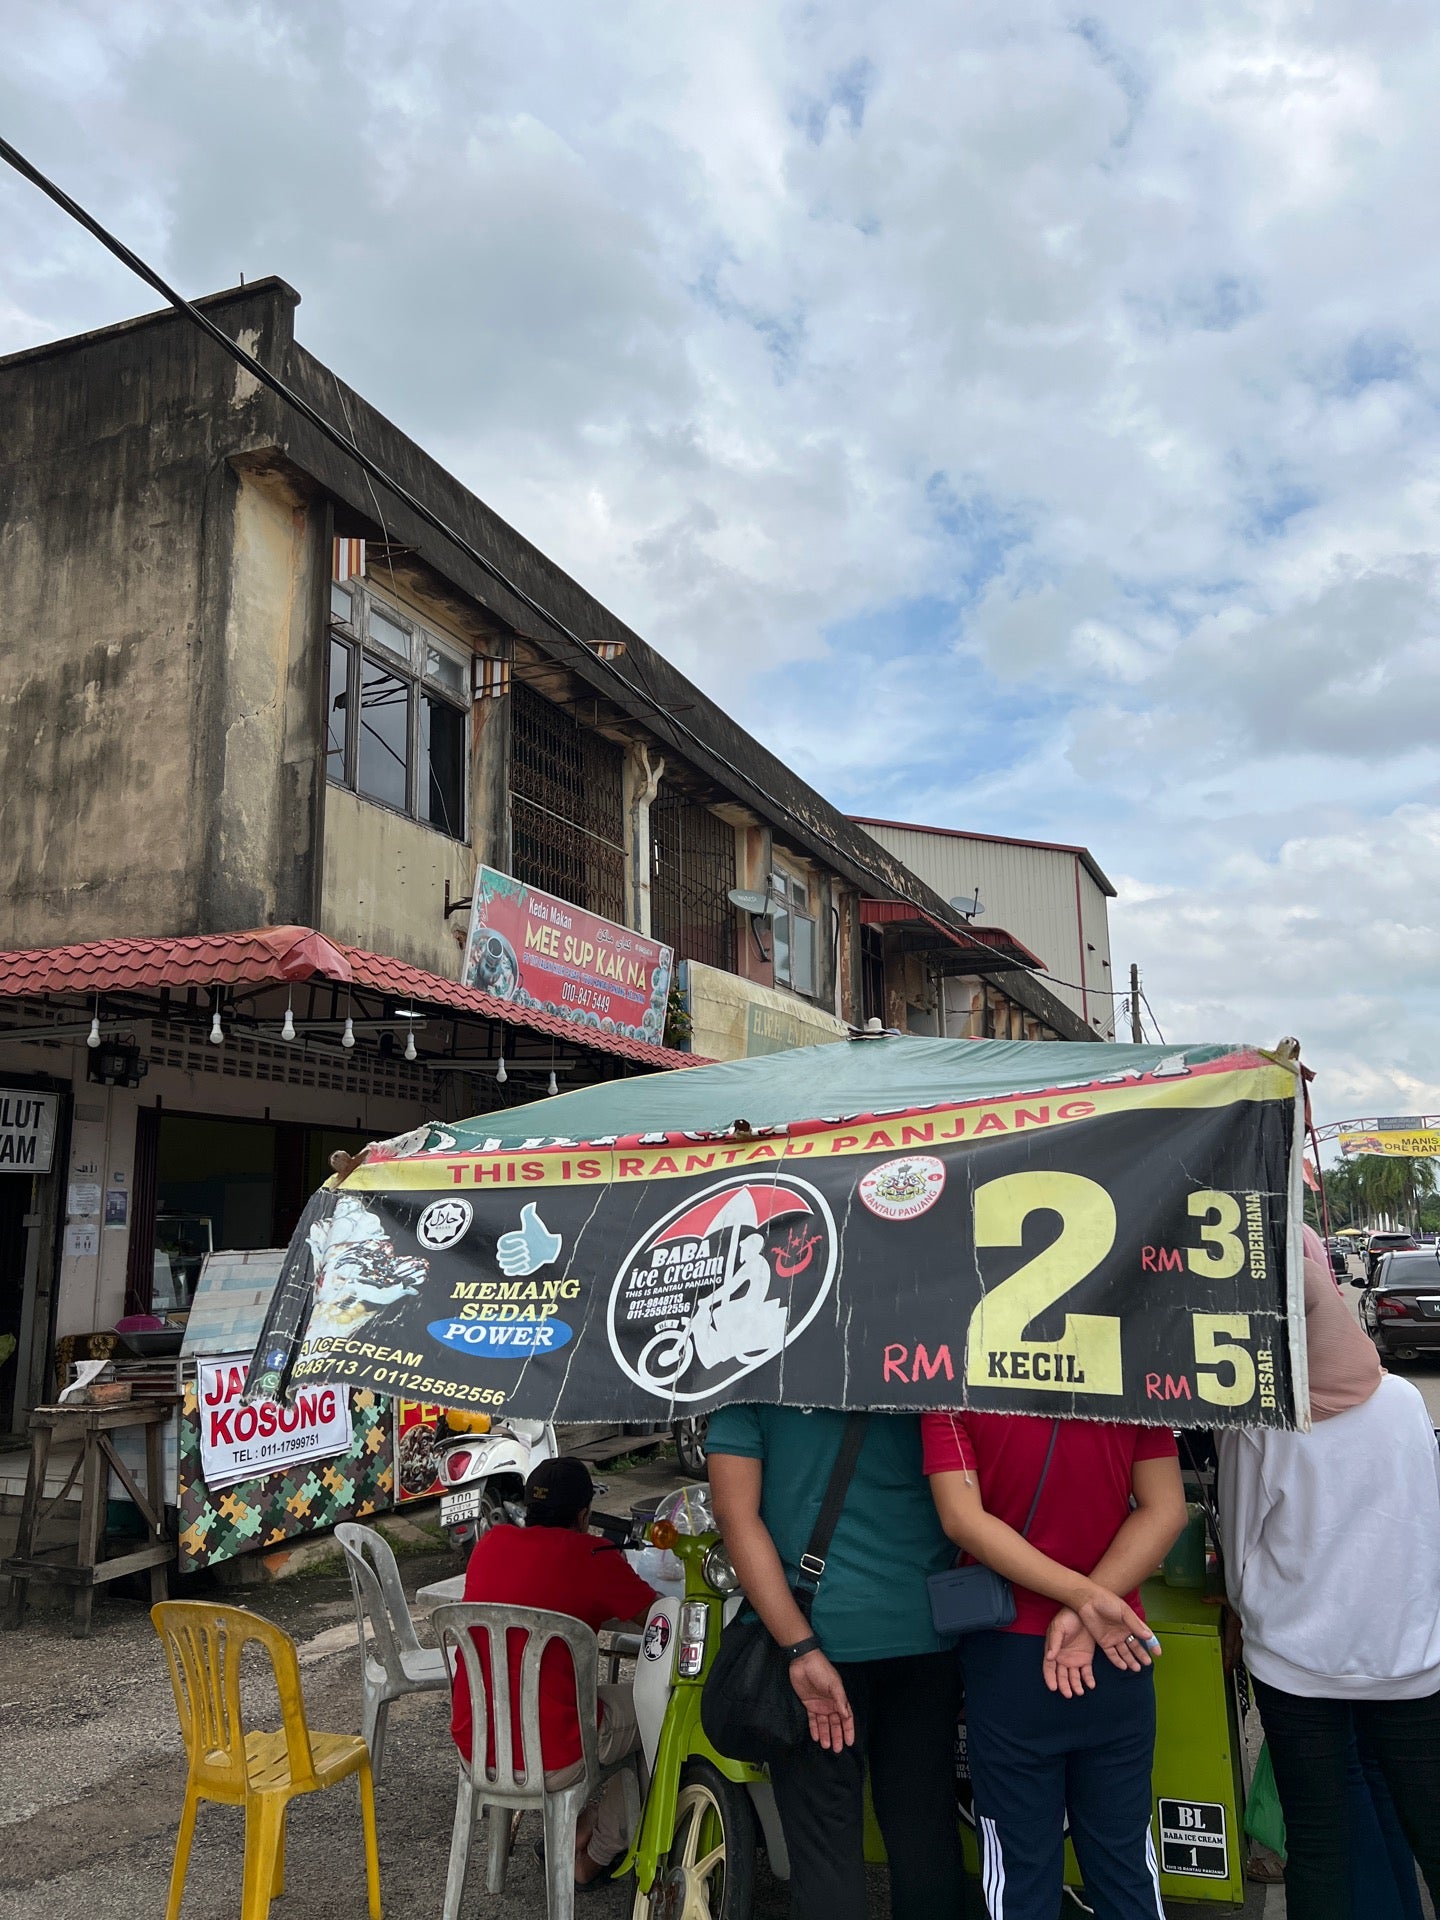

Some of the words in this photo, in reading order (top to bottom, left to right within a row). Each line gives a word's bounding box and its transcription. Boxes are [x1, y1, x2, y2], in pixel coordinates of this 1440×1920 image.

[529, 897, 549, 920] Kedai
[550, 906, 572, 930] Makan
[525, 920, 561, 959] MEE
[563, 935, 594, 969] SUP
[596, 947, 625, 983] KAK
[627, 960, 646, 991] NA
[562, 981, 592, 1007] 010-847
[592, 993, 610, 1013] 5449
[0, 1098, 45, 1128] LUT
[0, 1134, 36, 1164] AM
[447, 1162, 545, 1184] THIS
[562, 1158, 601, 1180] IS
[619, 1141, 814, 1177] RANTAU
[832, 1101, 1097, 1152] PANJANG
[1402, 1137, 1439, 1145] MANIS
[865, 1192, 896, 1216] RANTAU
[898, 1190, 937, 1216] PANJANG
[1141, 1246, 1184, 1273] RM
[1187, 1190, 1245, 1279] 3
[1245, 1192, 1266, 1279] SEDERHANA
[651, 1239, 710, 1268] BABA
[625, 1290, 642, 1298] THIS
[653, 1283, 683, 1295] RANTAU
[685, 1276, 722, 1289] PANJANG
[629, 1268, 659, 1289] ice
[663, 1256, 724, 1284] cream
[967, 1170, 1124, 1396] 2
[450, 1279, 581, 1300] MEMANG
[460, 1303, 558, 1322] SEDAP
[443, 1323, 554, 1346] POWER
[311, 1337, 424, 1368] ICECREAM
[883, 1343, 954, 1384] RM
[988, 1351, 1085, 1384] KECIL
[1192, 1313, 1256, 1407] 5
[205, 1365, 249, 1406] JA
[291, 1358, 359, 1379] 848713
[373, 1367, 505, 1406] 01125582556
[1146, 1372, 1192, 1401] RM
[1258, 1350, 1276, 1408] BESAR
[211, 1390, 335, 1447] KOSONG
[399, 1399, 444, 1425] PE
[233, 1449, 252, 1463] TEL
[261, 1434, 319, 1457] 011-17999751
[446, 1510, 473, 1524] 5013
[682, 1647, 698, 1661] 70
[1178, 1806, 1206, 1829] BL
[1164, 1831, 1183, 1841] BABA
[1184, 1834, 1196, 1842] ICE
[1198, 1835, 1223, 1845] CREAM
[1190, 1847, 1198, 1866] 1
